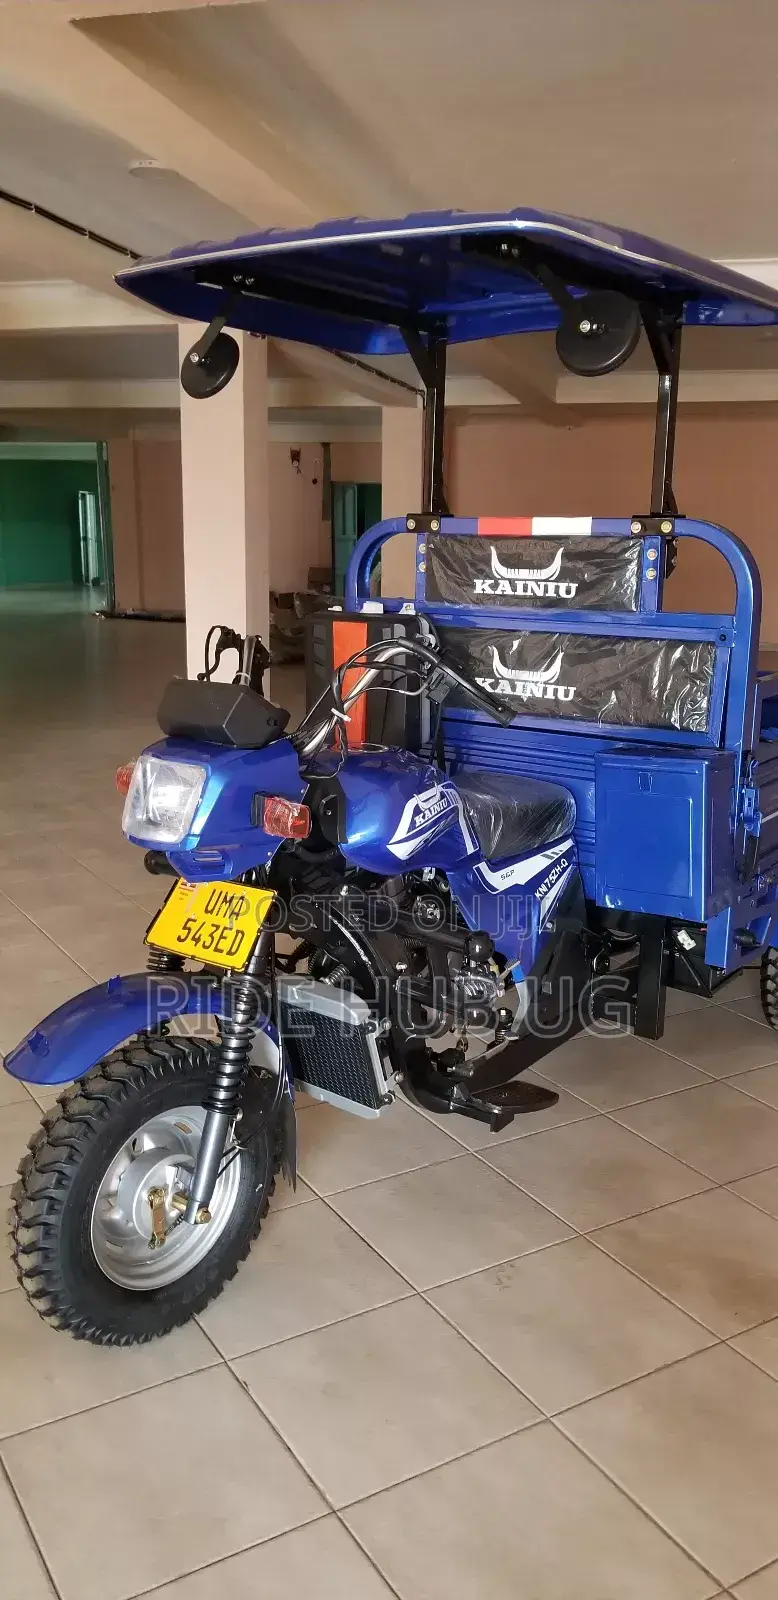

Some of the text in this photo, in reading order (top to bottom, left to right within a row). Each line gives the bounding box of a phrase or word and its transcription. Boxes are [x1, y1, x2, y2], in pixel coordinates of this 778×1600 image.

[474, 578, 578, 599] KAINIU
[474, 676, 577, 702] KAINIU
[414, 797, 449, 828] KAINIU
[203, 888, 246, 921] UMA
[176, 917, 246, 957] 543ED
